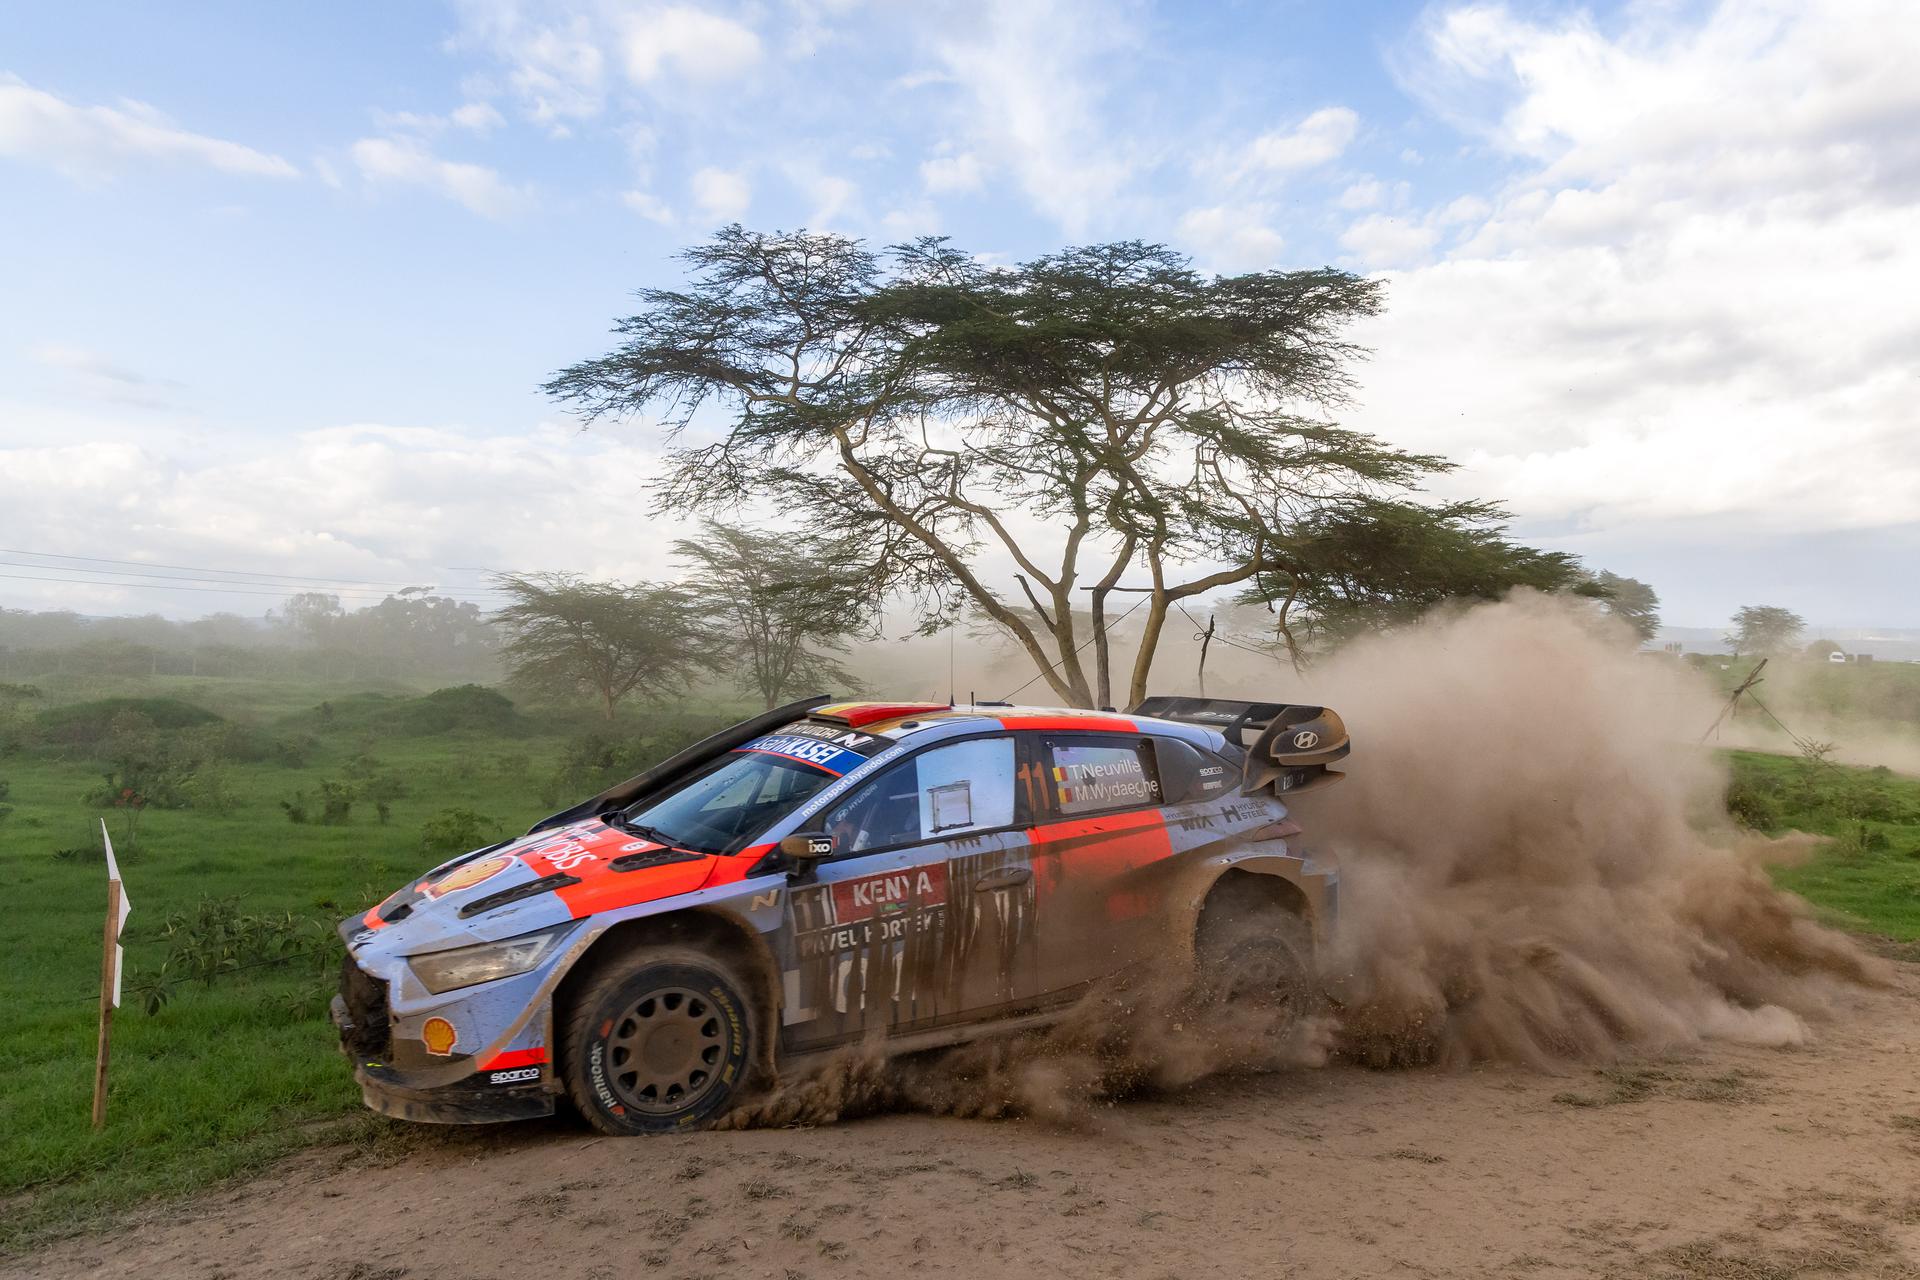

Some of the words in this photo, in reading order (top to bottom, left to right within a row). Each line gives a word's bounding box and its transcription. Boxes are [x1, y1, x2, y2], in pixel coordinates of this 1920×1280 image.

[802, 746, 905, 818] motorsport.hyundai.com
[1068, 759, 1142, 780] T.Neuville
[1200, 767, 1224, 776] sparco
[849, 784, 879, 811] HYUNDAI
[1018, 761, 1050, 813] 11
[853, 872, 933, 907] KENYA
[490, 1068, 540, 1084] sparco
